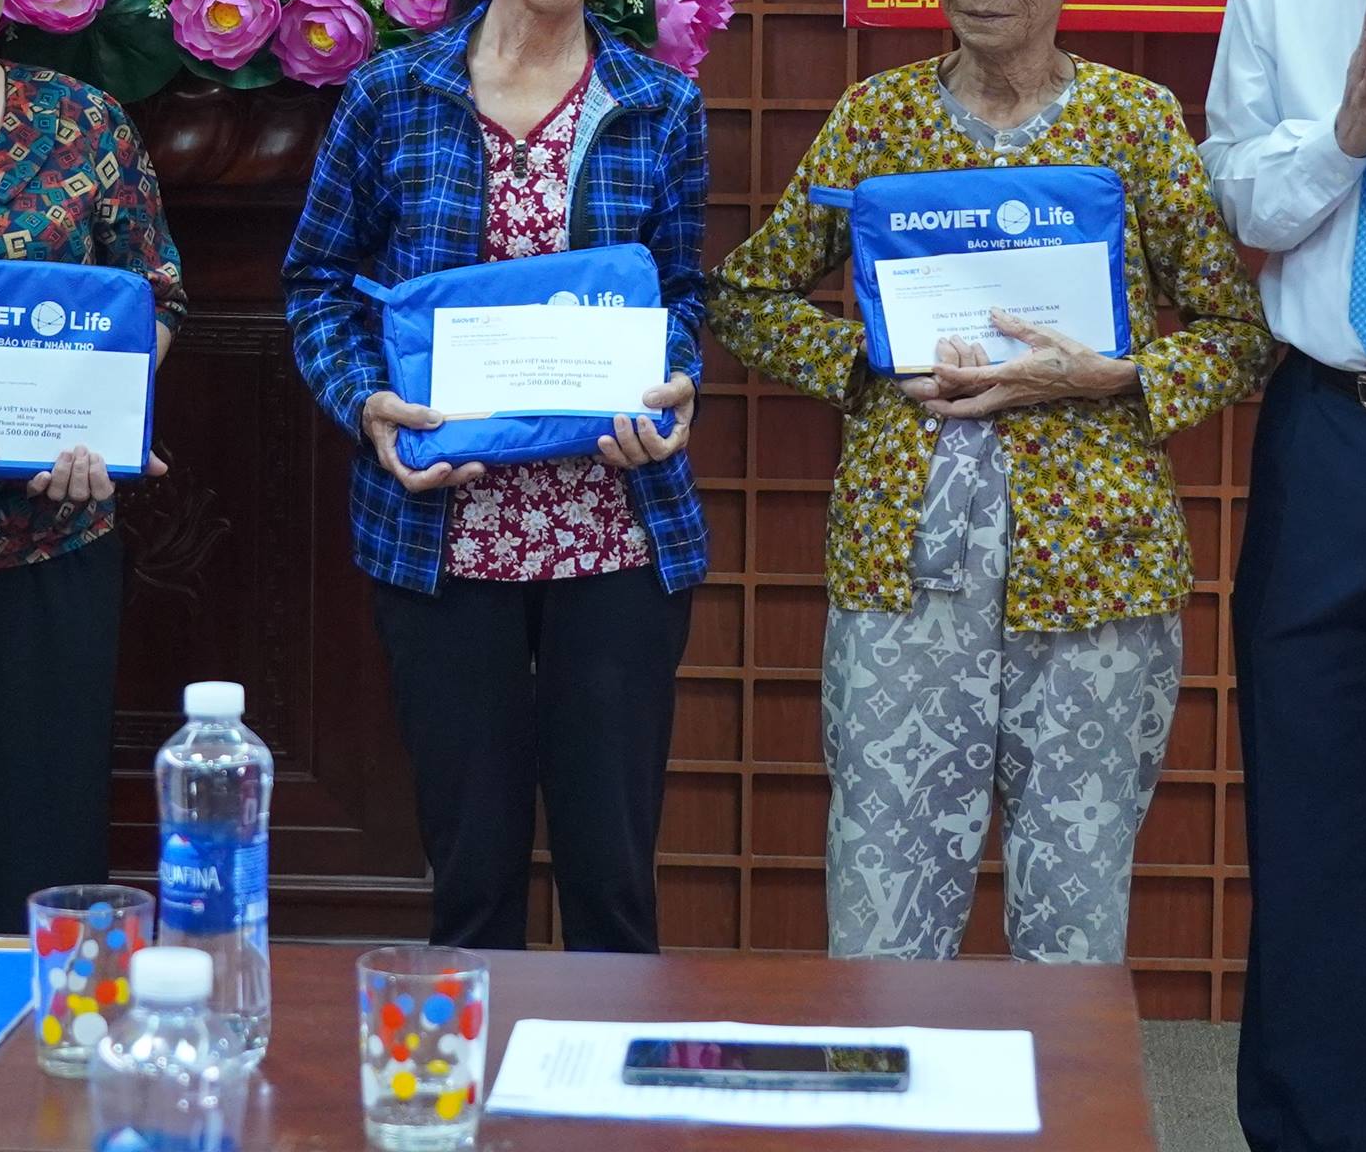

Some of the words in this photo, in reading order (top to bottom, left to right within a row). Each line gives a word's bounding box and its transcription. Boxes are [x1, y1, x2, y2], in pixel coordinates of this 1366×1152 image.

[891, 209, 990, 231] BAOVIET
[1035, 207, 1074, 225] Life
[967, 239, 988, 249] BẢO
[990, 238, 1011, 249] VIỆT
[1013, 237, 1040, 247] NHÂN
[583, 291, 625, 307] Life
[71, 311, 111, 331] Life
[161, 861, 221, 892] QUAFINA
